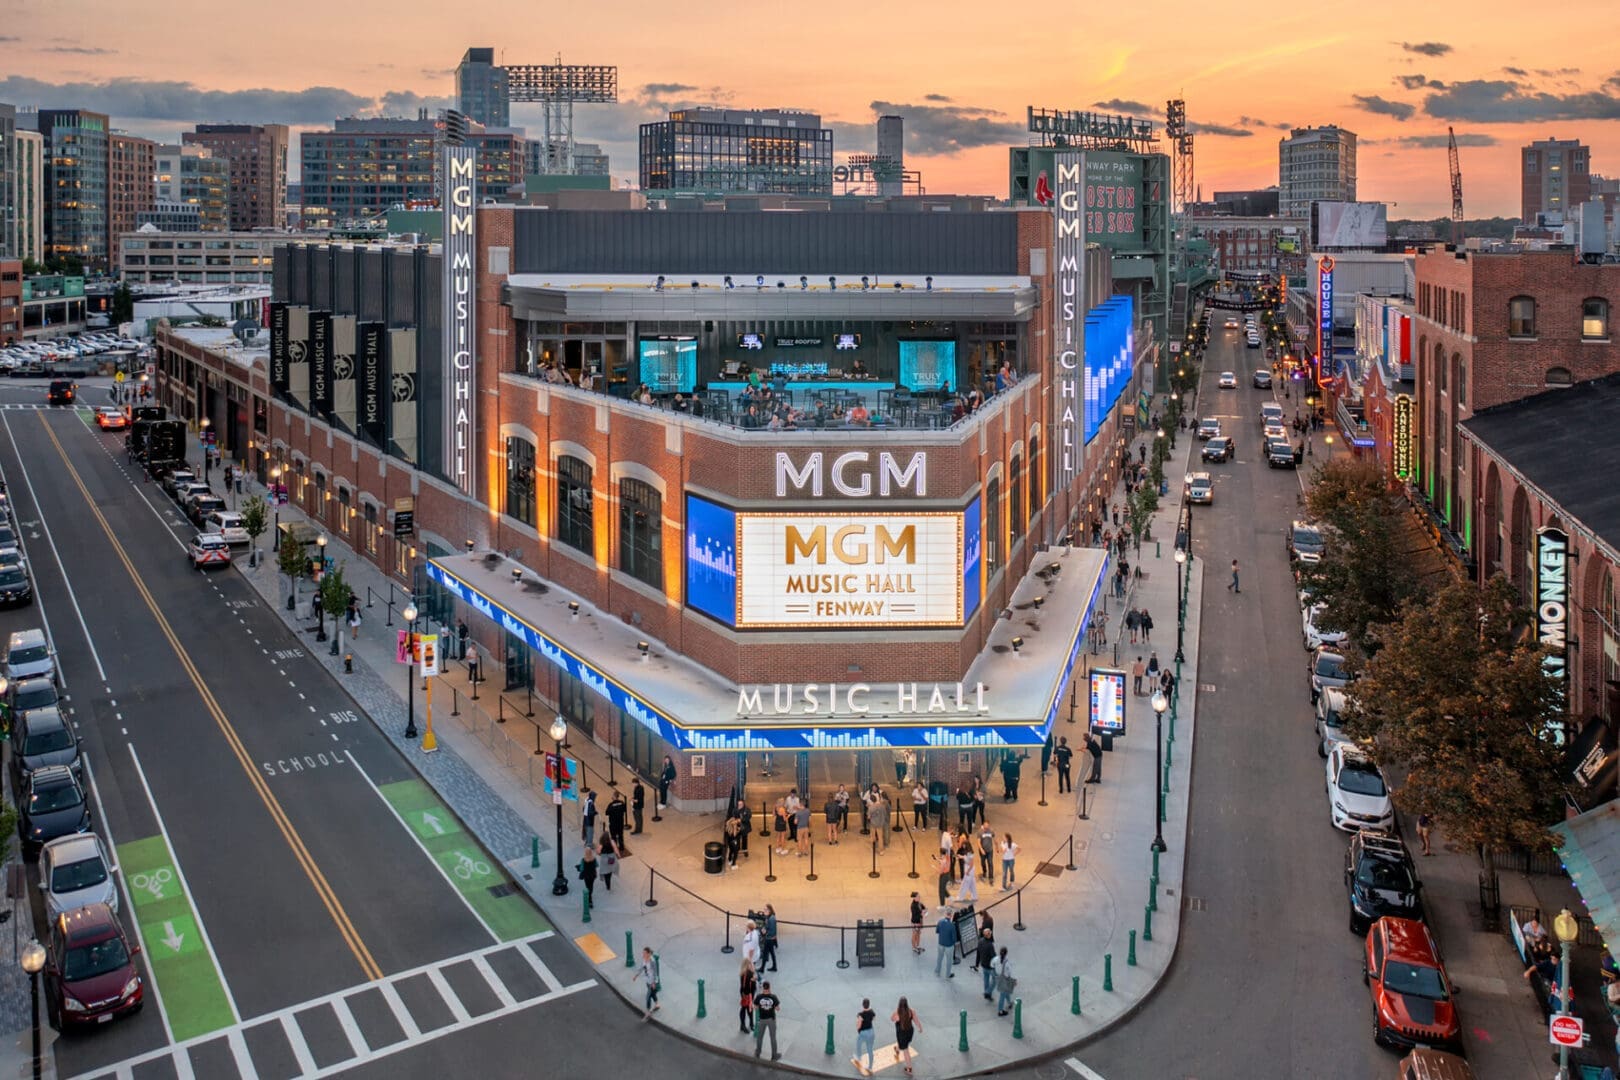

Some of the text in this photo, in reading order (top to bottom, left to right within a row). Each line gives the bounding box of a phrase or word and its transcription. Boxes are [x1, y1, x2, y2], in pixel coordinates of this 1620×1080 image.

[1086, 161, 1135, 173] NWAY PARK
[1086, 185, 1136, 209] OSTON
[1086, 211, 1136, 234] ED SOX
[451, 157, 473, 475] MGM MUSIC HALL
[1321, 273, 1332, 319] HOUSE
[1058, 163, 1080, 471] MGM MUSIC HALL
[274, 308, 284, 382] MGM MUSIC HALL
[315, 318, 325, 400] MGM MUSIC HALL
[1322, 331, 1332, 377] BLUES
[366, 330, 377, 423] MGM MUSIC HALL
[913, 372, 942, 381] TRULY
[1399, 404, 1408, 468] LANSDOWNE
[776, 451, 927, 497] MGM
[785, 524, 916, 565] MGM
[785, 573, 916, 594] MUSIC HALL
[1539, 536, 1566, 649] MONKEY
[816, 600, 885, 617] FENWAY
[275, 648, 305, 660] BIKE
[329, 710, 358, 724] BUS
[736, 681, 990, 715] MUSIC HALL
[263, 751, 345, 777] SCHOOL
